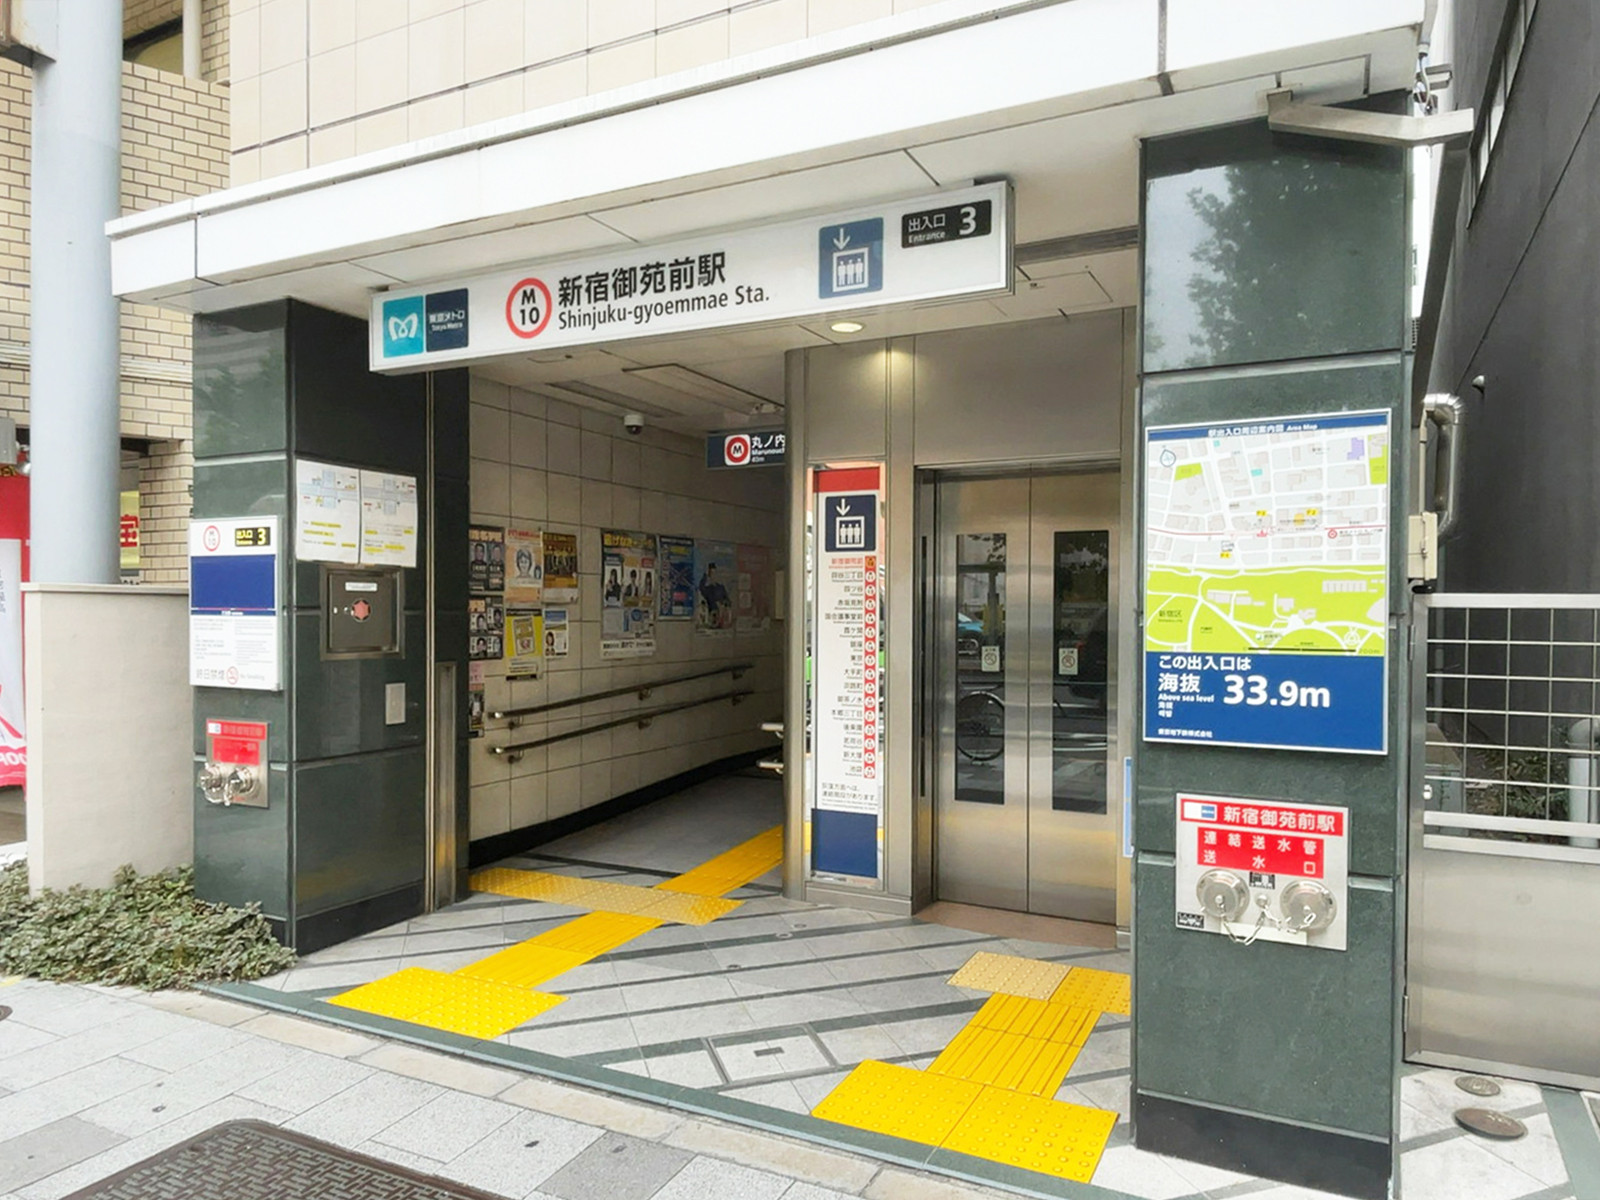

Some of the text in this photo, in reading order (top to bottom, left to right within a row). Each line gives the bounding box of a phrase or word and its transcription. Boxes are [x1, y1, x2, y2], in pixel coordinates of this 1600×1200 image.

[908, 206, 977, 236] 出入口 3
[908, 231, 945, 243] Entrance
[558, 251, 726, 309] 新宿御苑前駅
[521, 288, 536, 306] M
[558, 284, 770, 330] Shinjuku-gyoemmae Sta.
[519, 306, 540, 326] 10
[1286, 424, 1302, 432] Area
[1303, 423, 1319, 431] Map
[732, 445, 742, 455] M
[257, 528, 266, 545] 3
[1159, 656, 1252, 672] この出入口は
[1158, 673, 1201, 693] 海抜
[1223, 675, 1330, 707] 33.9m
[1158, 693, 1215, 703] Above sea level
[1223, 806, 1335, 832] 新宿御苑前駅
[1203, 830, 1317, 855] 連結送水管
[1203, 849, 1316, 875] 送水口
